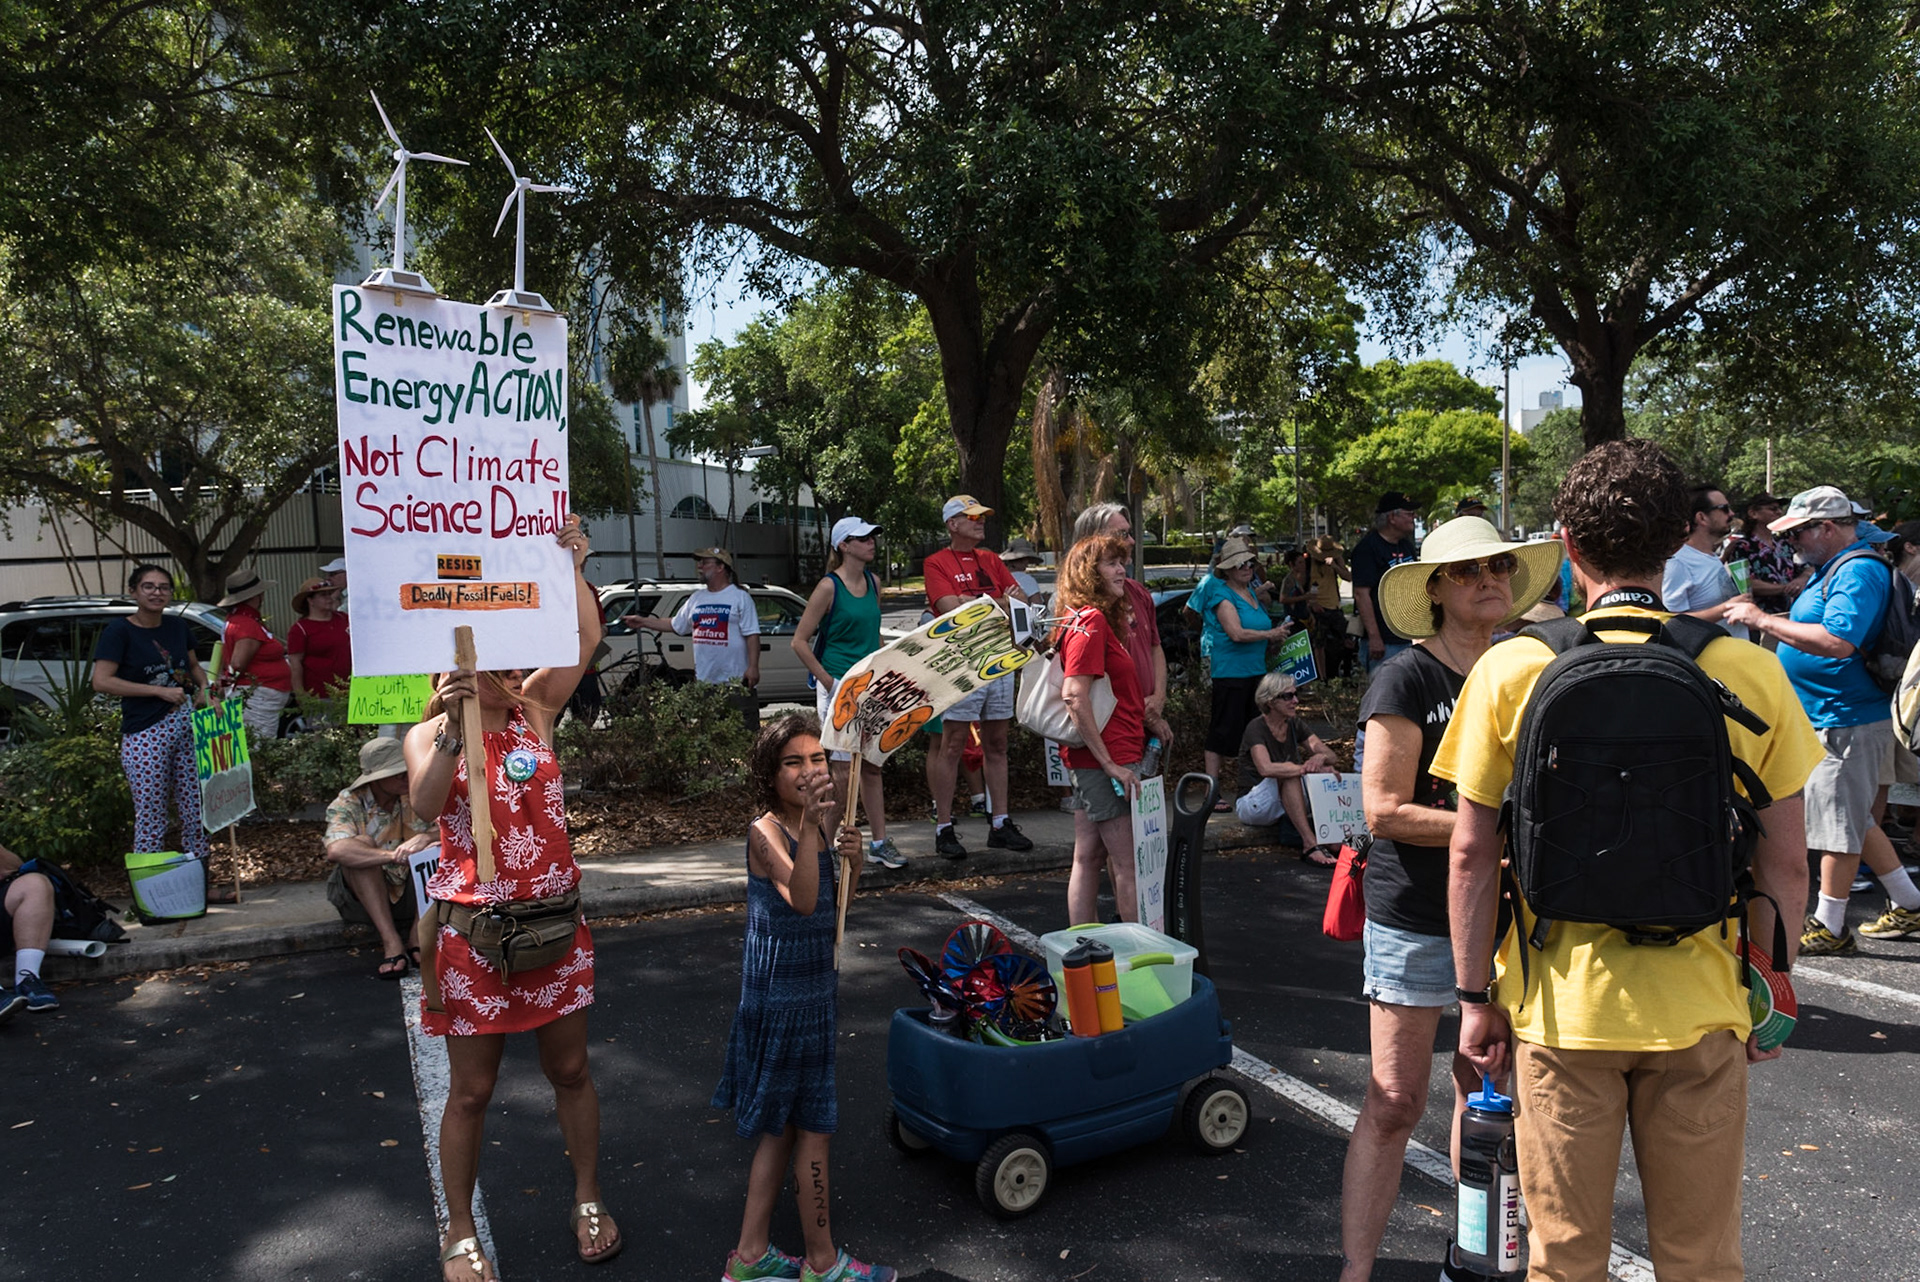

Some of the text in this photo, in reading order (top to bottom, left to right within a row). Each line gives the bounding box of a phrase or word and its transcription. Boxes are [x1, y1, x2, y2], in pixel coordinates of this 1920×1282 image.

[340, 289, 537, 364] Renewable
[342, 350, 566, 432] Energy ACTION,
[343, 434, 561, 484] Not Climate
[350, 481, 483, 538] Science
[437, 557, 482, 572] RESIST
[954, 572, 973, 583] 13.1
[411, 584, 452, 608] Deadly
[489, 583, 532, 604] Fuels!
[1600, 591, 1654, 606] Canon
[700, 617, 718, 626] NOT
[375, 677, 410, 696] with
[194, 697, 243, 740] SCIENCE
[352, 696, 398, 720] Mother
[195, 736, 213, 780] IS
[232, 729, 245, 767] A
[1048, 745, 1063, 782] LOVE
[1337, 795, 1352, 808] NO
[1328, 809, 1364, 823] PLANE
